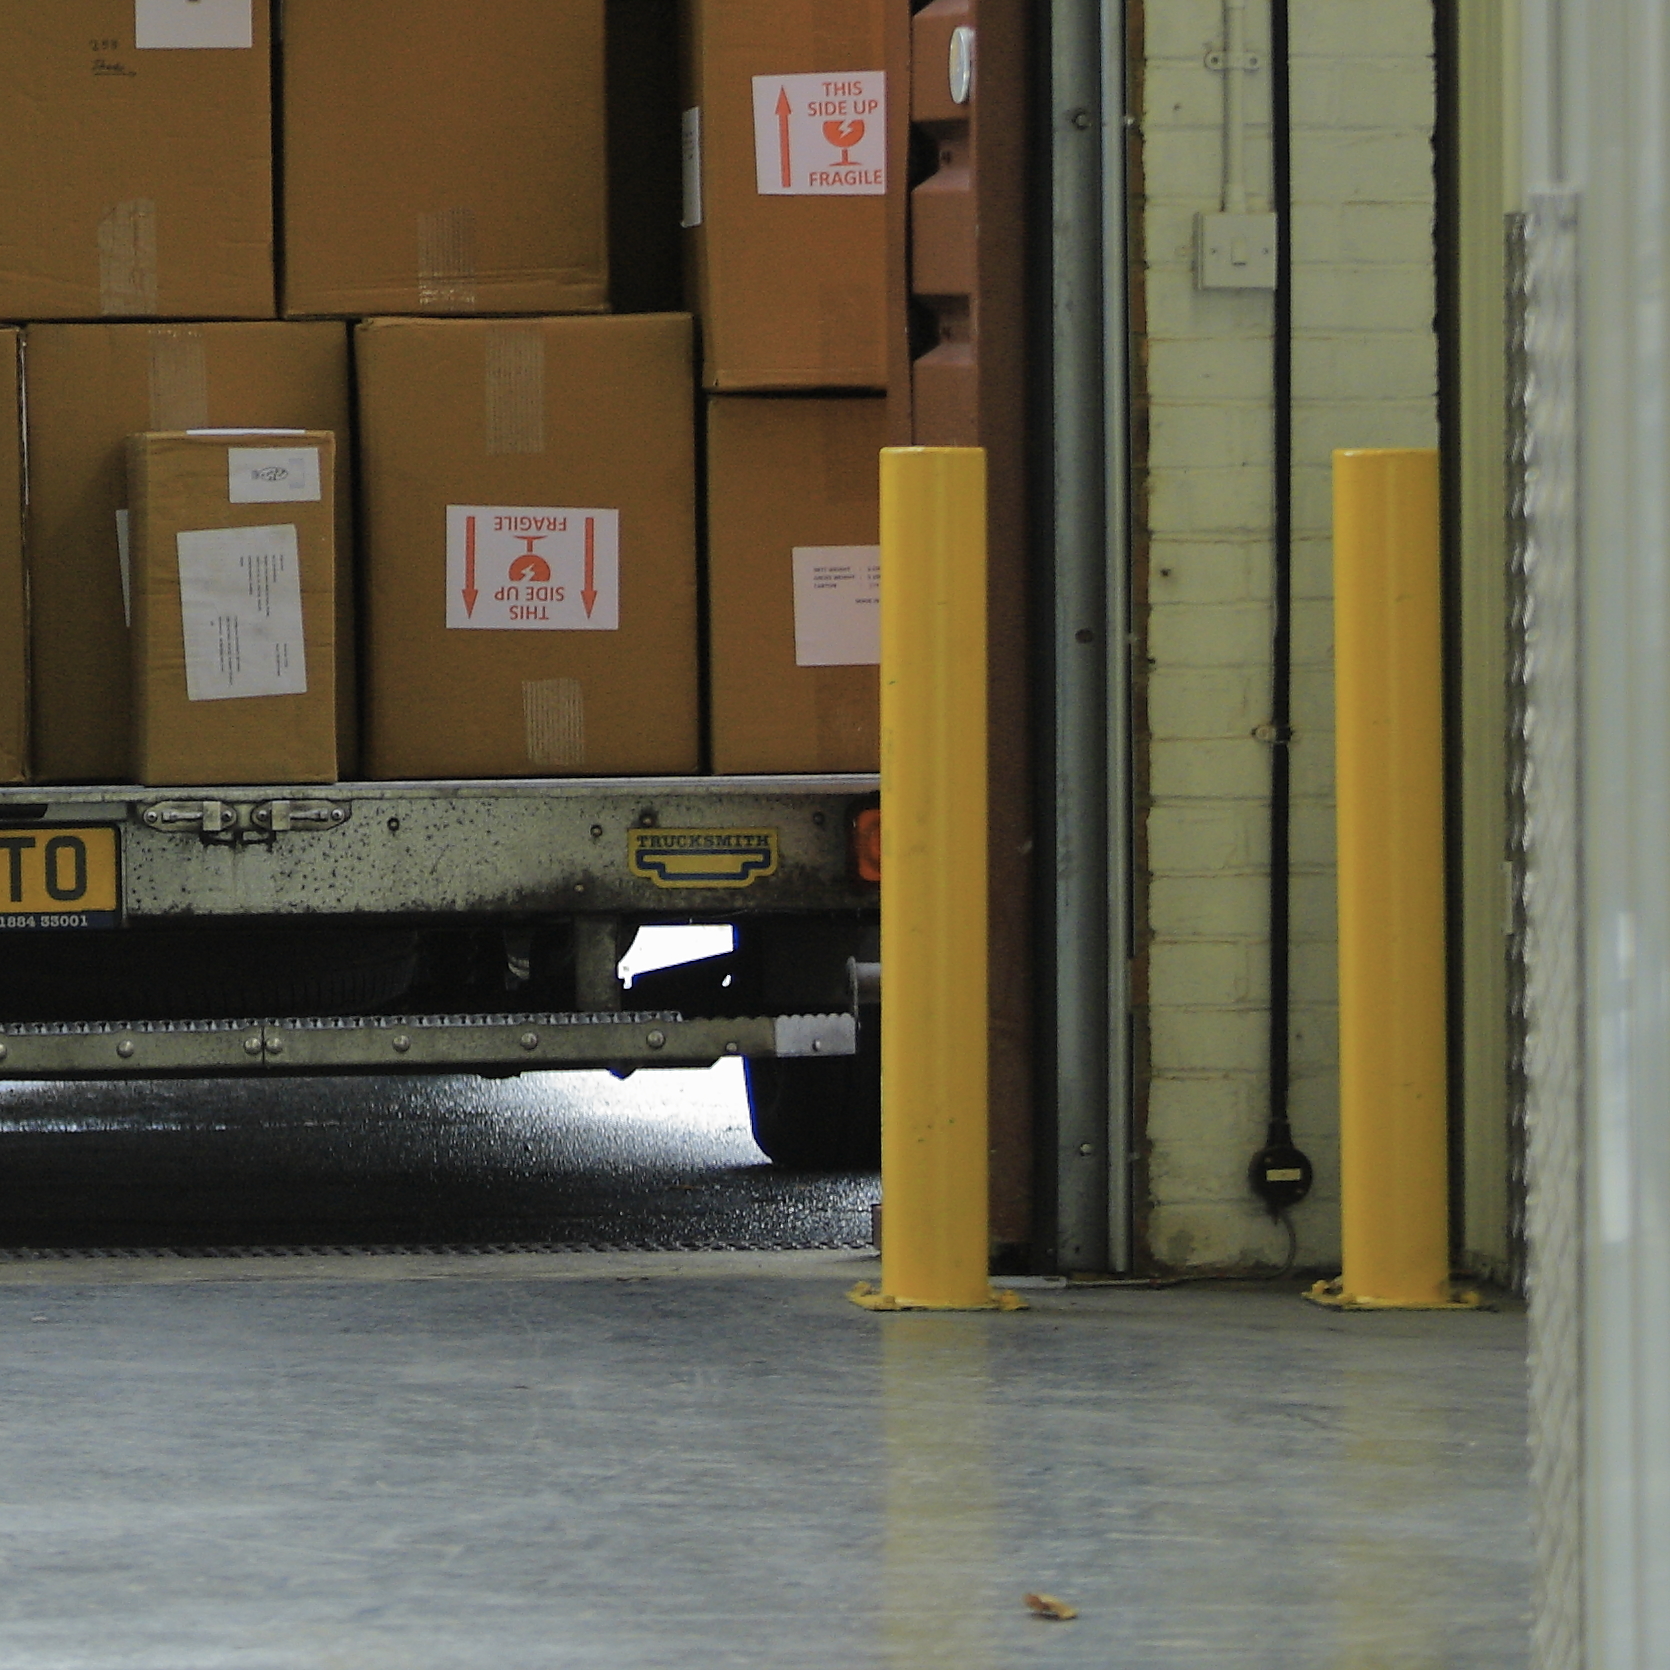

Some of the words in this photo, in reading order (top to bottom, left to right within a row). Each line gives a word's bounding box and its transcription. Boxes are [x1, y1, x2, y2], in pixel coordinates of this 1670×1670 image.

[822, 81, 862, 97] THIS
[807, 101, 847, 117] SIDE
[853, 99, 878, 115] UP
[809, 170, 883, 186] FRAGILE
[494, 515, 567, 531] FRAGILE
[494, 586, 519, 601] UP
[526, 586, 564, 602] SIDE
[510, 605, 549, 620] THIS
[637, 834, 769, 848] TRUCKSMITH
